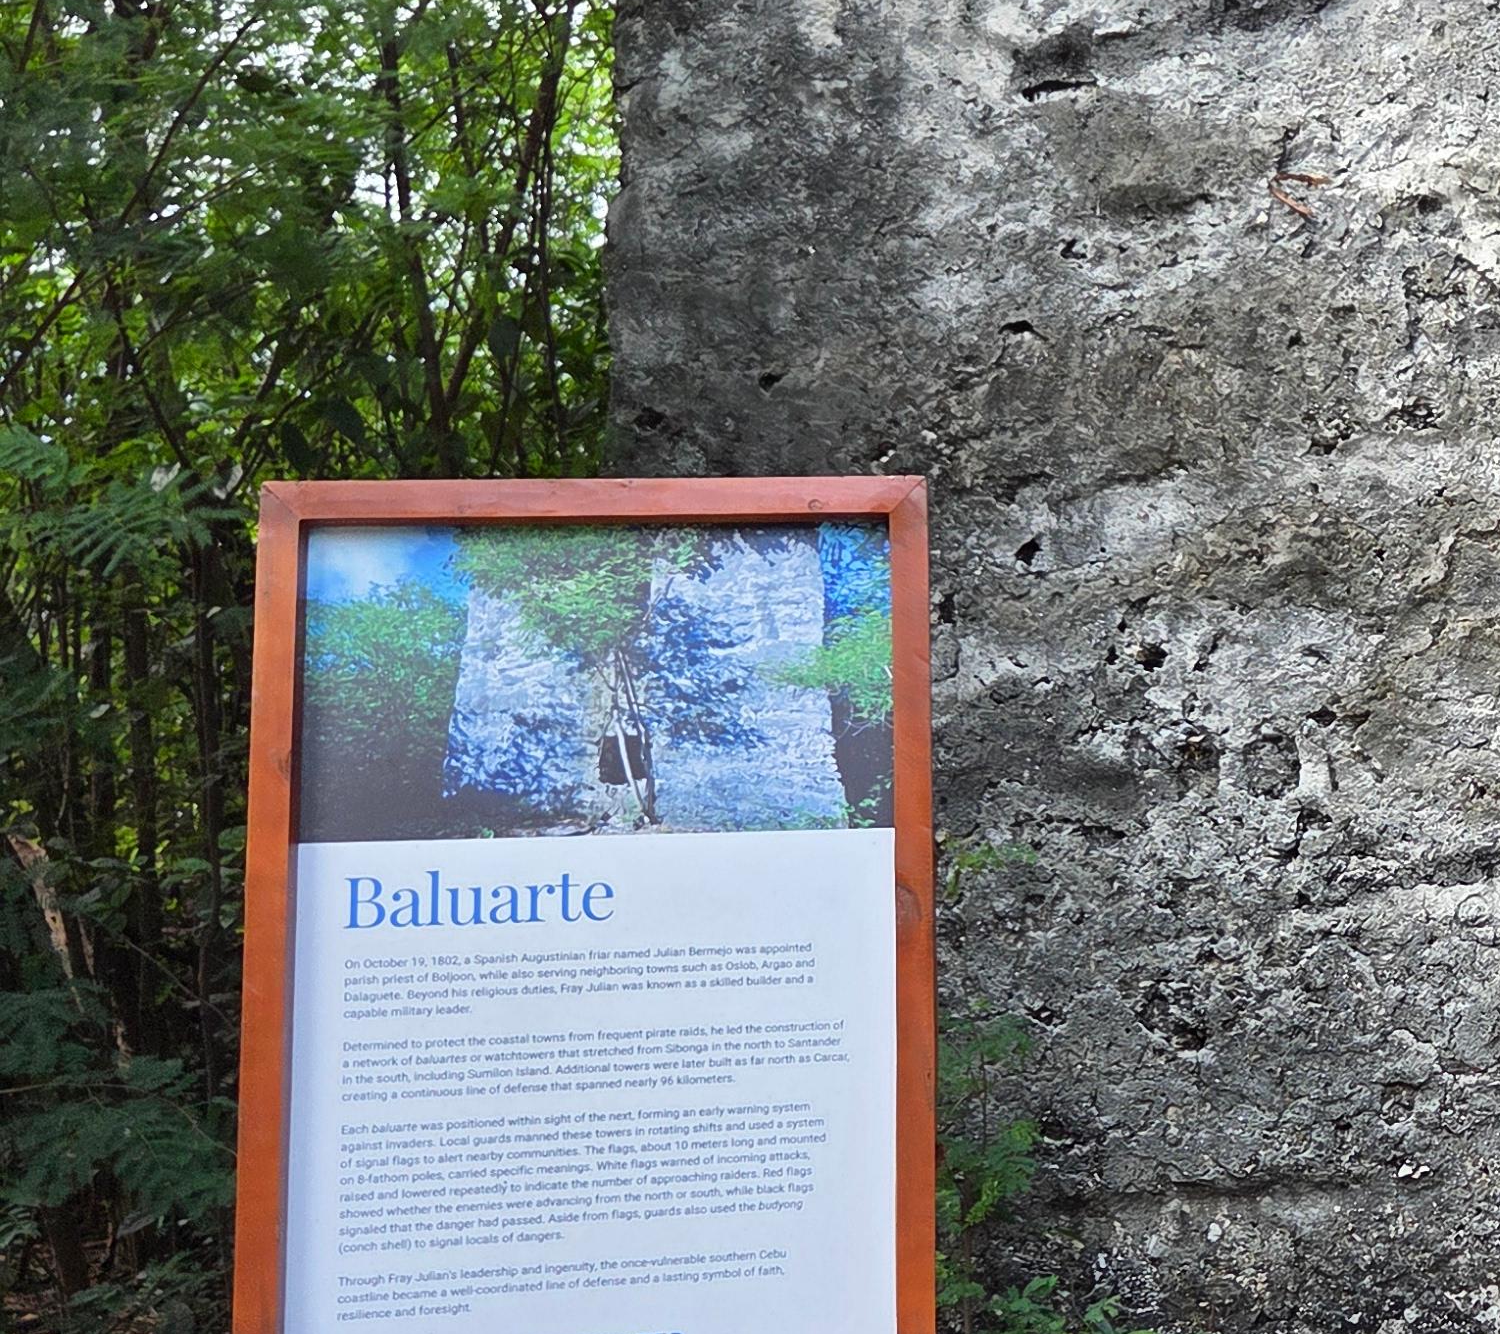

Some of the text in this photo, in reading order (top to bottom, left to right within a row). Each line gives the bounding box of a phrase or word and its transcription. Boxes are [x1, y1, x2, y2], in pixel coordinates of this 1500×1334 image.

[343, 868, 614, 929] Baluarte
[344, 943, 811, 969] On October 19, 1802, a Spanish Augustinian friar named Julian Bermejo was appointed
[344, 958, 815, 987] parish priest of Boljoon, while also serving neighboring towns such as Oslob, Argao and
[343, 974, 813, 1004] Dalaguete. Beyond his religious duties, Fray Julian was known as a skilled builder and a
[343, 1003, 472, 1020] capable military leader.
[342, 1020, 844, 1051] Determined to protect the coastal towns from frequent pirate raids, he led the construction of
[342, 1036, 840, 1068] a network of baluartes or watchtowers that stretched from Sibonga in the north to Santander
[342, 1075, 352, 1085] in
[355, 1074, 374, 1083] the
[376, 1072, 411, 1084] south,
[413, 1069, 465, 1083] including
[466, 1067, 513, 1079] Sumilon
[515, 1065, 552, 1076] Island.
[555, 1063, 610, 1074] Additional
[613, 1062, 650, 1071] towers
[652, 1061, 679, 1069] were
[681, 1058, 705, 1068] later
[708, 1057, 732, 1067] built
[734, 1058, 747, 1066] as
[750, 1055, 765, 1065] far
[767, 1054, 795, 1064] north
[798, 1055, 811, 1063] as
[341, 1073, 735, 1103] creating a continuous line of defense that spanned nearly 96 kilometers.
[339, 1150, 810, 1185] on 8-fathom poles, carried specific meanings. White flags warned of incoming attacks,
[338, 1230, 564, 1255] (conch shell) to signal locals of dangers.
[337, 1274, 385, 1289] Through
[388, 1272, 413, 1285] Fray
[414, 1269, 457, 1282] Julian's
[459, 1266, 518, 1280] leadership
[521, 1264, 542, 1275] and
[544, 1262, 598, 1276] ingenuity,
[600, 1260, 618, 1269] the
[709, 1251, 756, 1262] southern
[759, 1248, 786, 1259] Cebu
[337, 1291, 389, 1304] coastline
[392, 1288, 437, 1300] became
[440, 1289, 447, 1297] a
[449, 1281, 543, 1296] well-coordinated
[545, 1279, 566, 1290] line
[568, 1278, 580, 1288] of
[582, 1275, 627, 1287] defense
[629, 1273, 650, 1284] and
[652, 1275, 660, 1283] a
[662, 1271, 699, 1284] lasting
[702, 1268, 741, 1281] symbol
[743, 1266, 755, 1277] of
[336, 1308, 392, 1321] resilience
[394, 1306, 416, 1317] and
